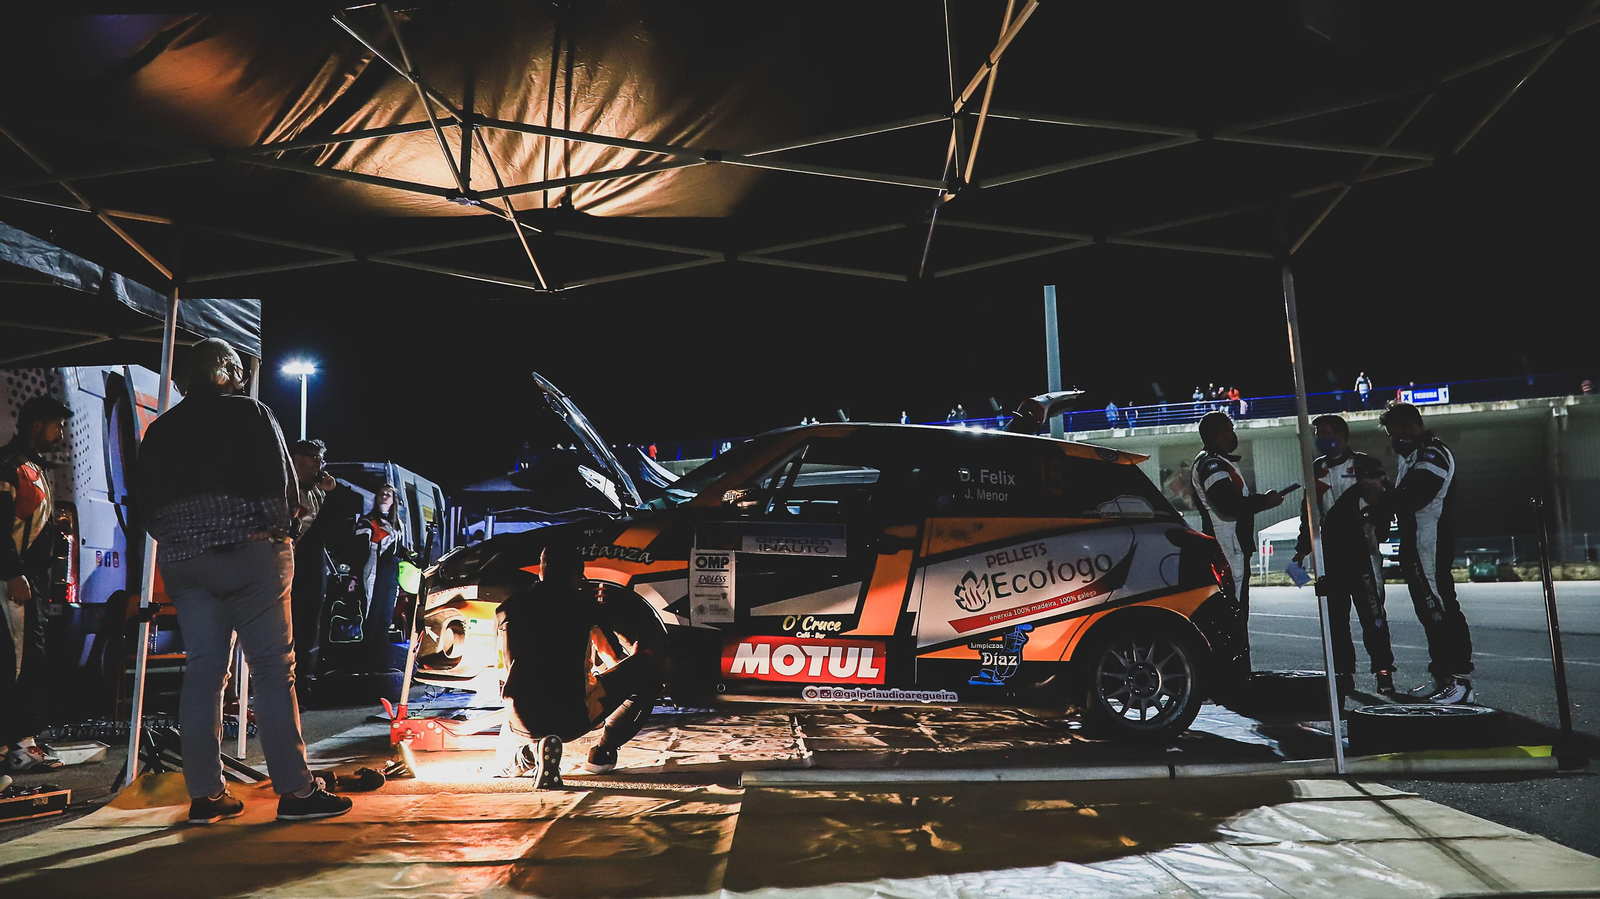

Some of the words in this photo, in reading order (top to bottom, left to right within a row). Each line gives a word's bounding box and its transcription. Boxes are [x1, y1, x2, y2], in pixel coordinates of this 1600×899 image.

[958, 467, 974, 483] D.
[980, 468, 1016, 486] Felix
[964, 488, 974, 500] J.
[976, 488, 1010, 502] Menor
[758, 544, 830, 554] INAUTO
[985, 542, 1048, 569] PELLETS
[695, 556, 730, 569] OMP
[698, 574, 727, 583] ENDLESS
[991, 553, 1113, 599] Ecofogo
[990, 610, 1013, 622] enerxia
[1013, 604, 1031, 616] 100%
[1031, 598, 1059, 612] madeira,
[1060, 594, 1077, 606] 100%
[1077, 590, 1097, 603] galega
[802, 616, 842, 632] Cruce
[971, 642, 1004, 650] Limpiezas
[730, 643, 880, 678] MOTUL
[982, 652, 1018, 666] Díaz
[833, 688, 956, 703] @galpclaudioaregueira
